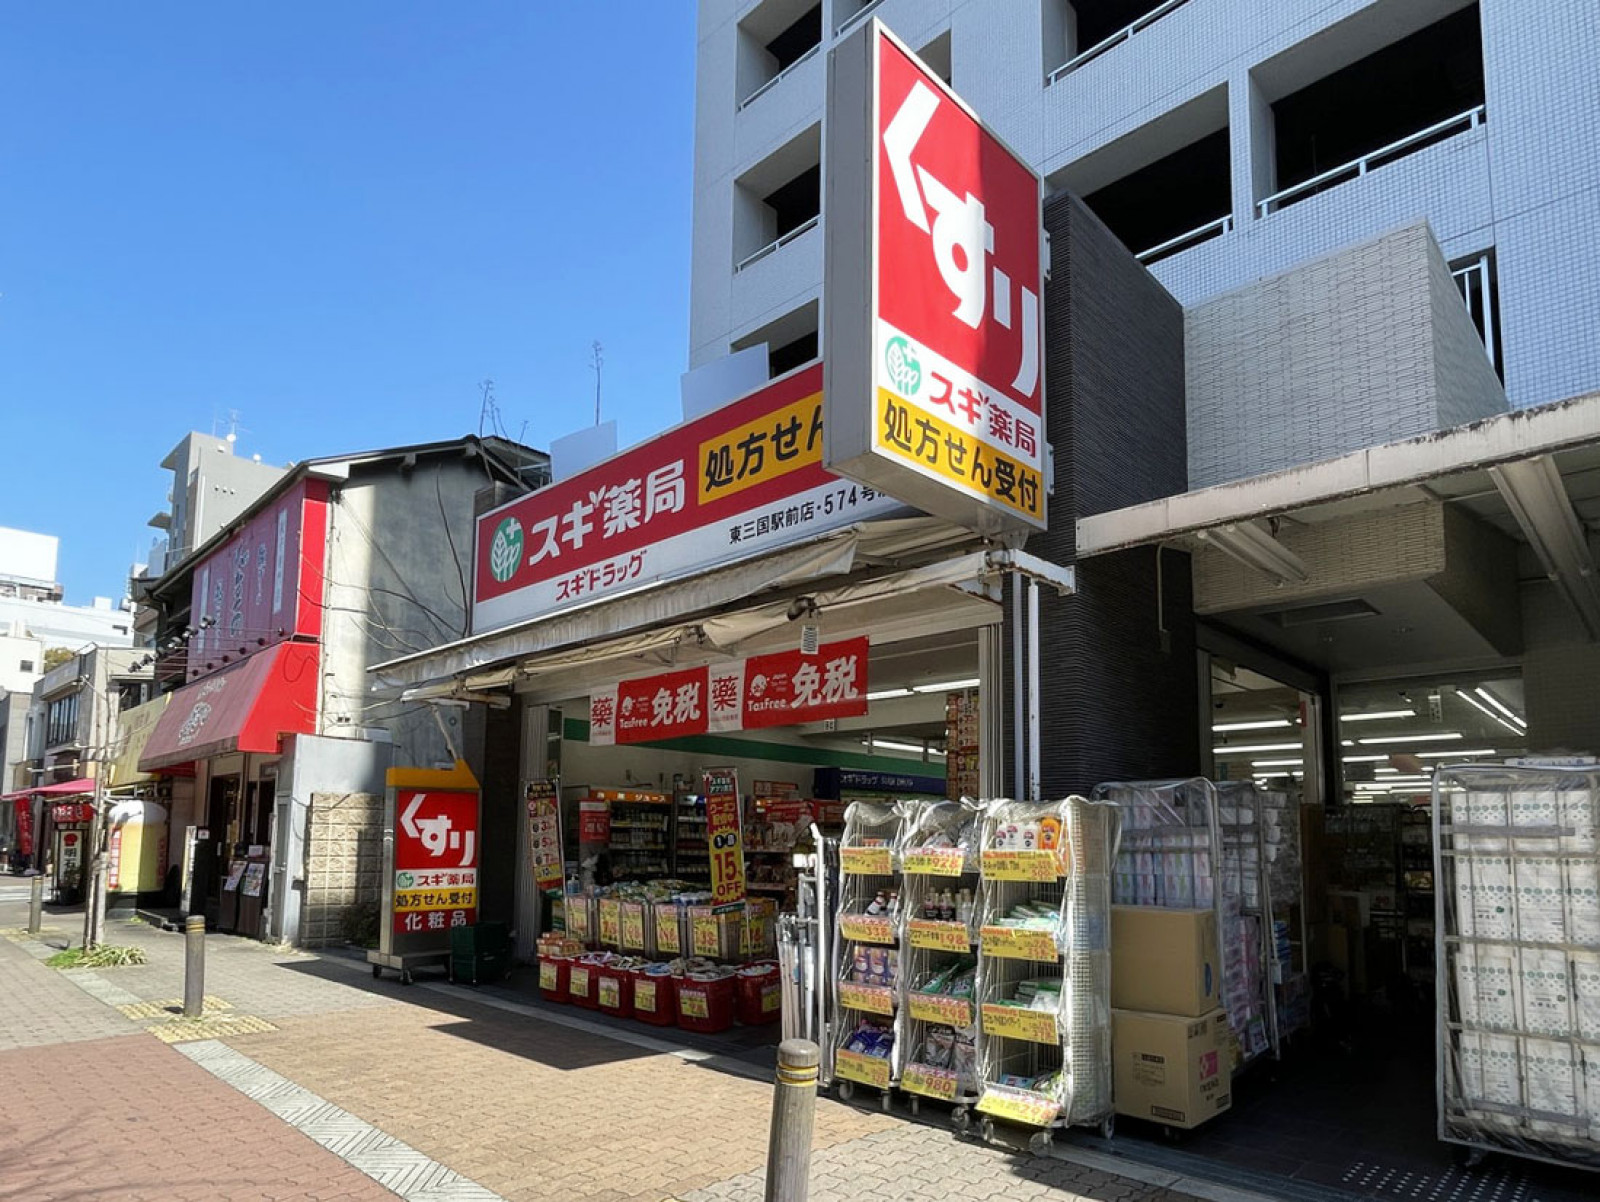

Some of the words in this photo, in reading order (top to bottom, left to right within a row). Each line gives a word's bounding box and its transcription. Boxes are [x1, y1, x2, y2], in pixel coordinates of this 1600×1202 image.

[883, 79, 1038, 399] くすり
[929, 371, 1036, 459] スギ薬局
[883, 397, 1039, 515] 処方せん受付
[529, 459, 685, 567] スギ薬局
[729, 484, 886, 546] 東三国駅前店・574号
[556, 549, 647, 602] スギドラッグ
[651, 682, 701, 727] 免税
[791, 654, 858, 709] 免税
[399, 793, 476, 867] くすり
[395, 891, 474, 907] 処方せん受付
[416, 873, 475, 887] スギ薬局
[717, 882, 742, 896] OFF
[404, 910, 467, 931] 化粧品
[925, 1078, 952, 1092] 980
